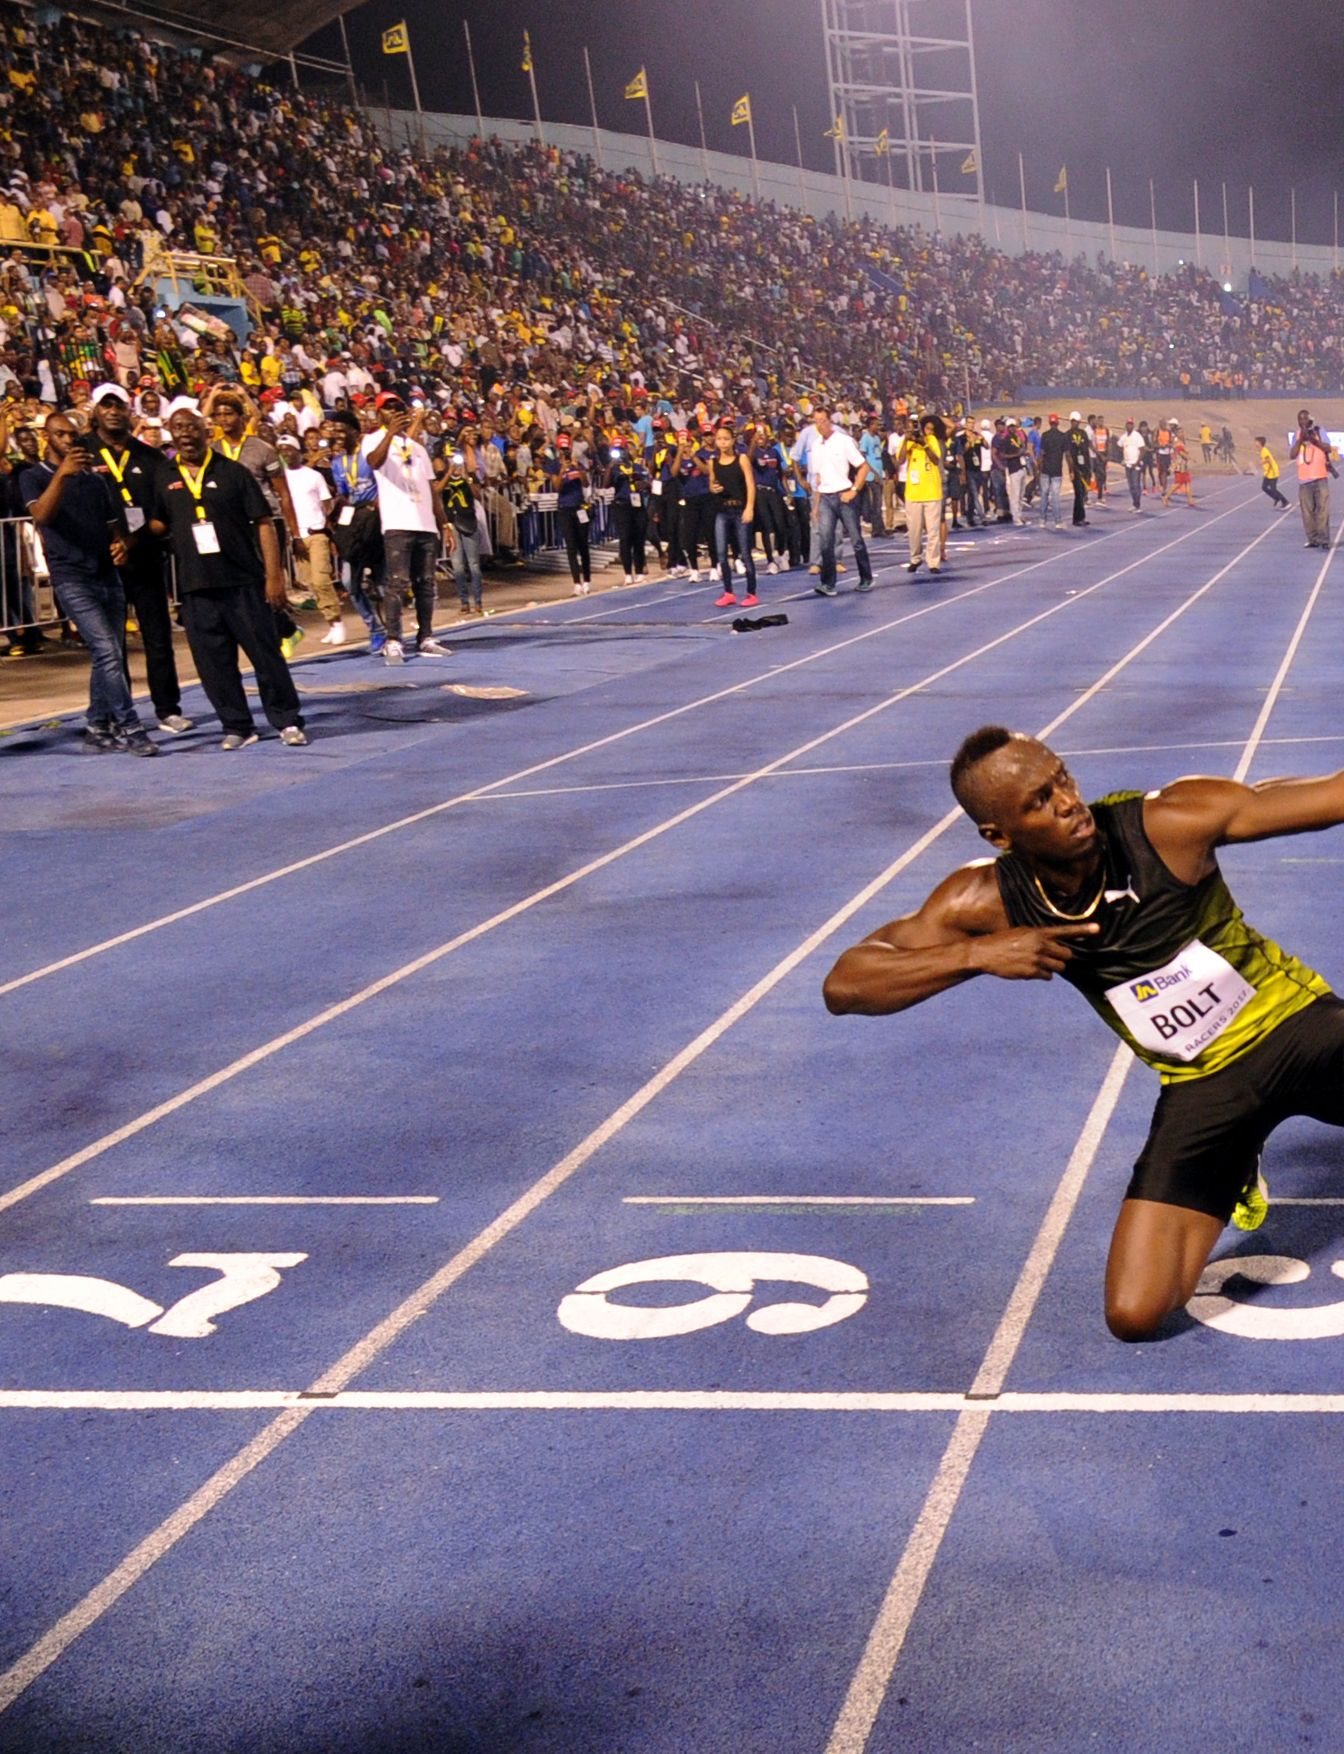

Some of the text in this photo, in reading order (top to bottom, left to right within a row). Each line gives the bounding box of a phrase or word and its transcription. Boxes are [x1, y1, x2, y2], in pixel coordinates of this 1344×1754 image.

[1154, 964, 1194, 990] Bank
[1150, 982, 1222, 1040] BOLT
[1185, 1015, 1228, 1052] RACERS
[0, 1252, 308, 1338] 7
[557, 1251, 870, 1341] 6
